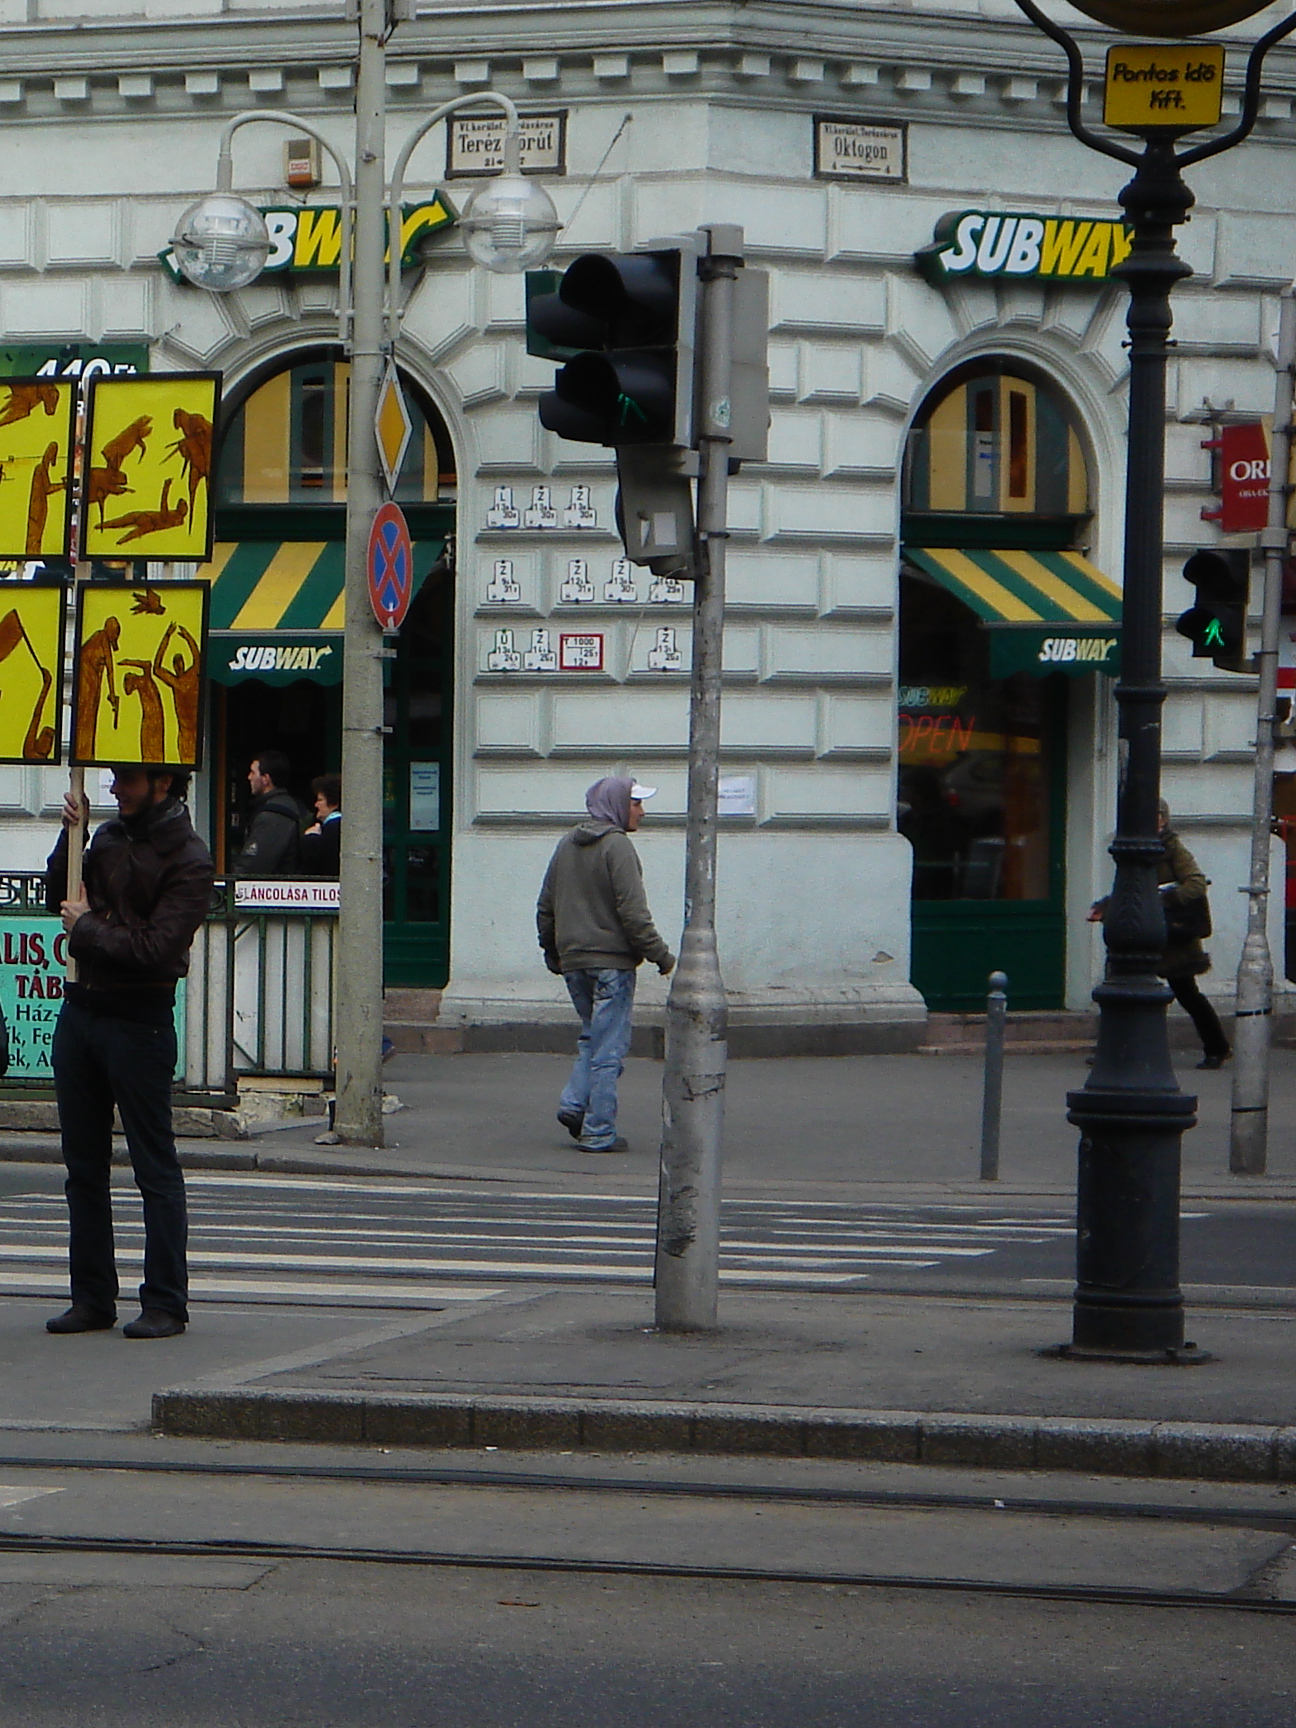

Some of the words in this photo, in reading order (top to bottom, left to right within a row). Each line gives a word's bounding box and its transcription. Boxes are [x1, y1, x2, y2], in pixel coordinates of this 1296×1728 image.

[459, 133, 501, 153] Teréz
[834, 136, 888, 163] Oktogon
[939, 214, 1135, 276] SUBWAY
[229, 645, 333, 670] SUBWAY
[1038, 638, 1118, 662] SUBWAY
